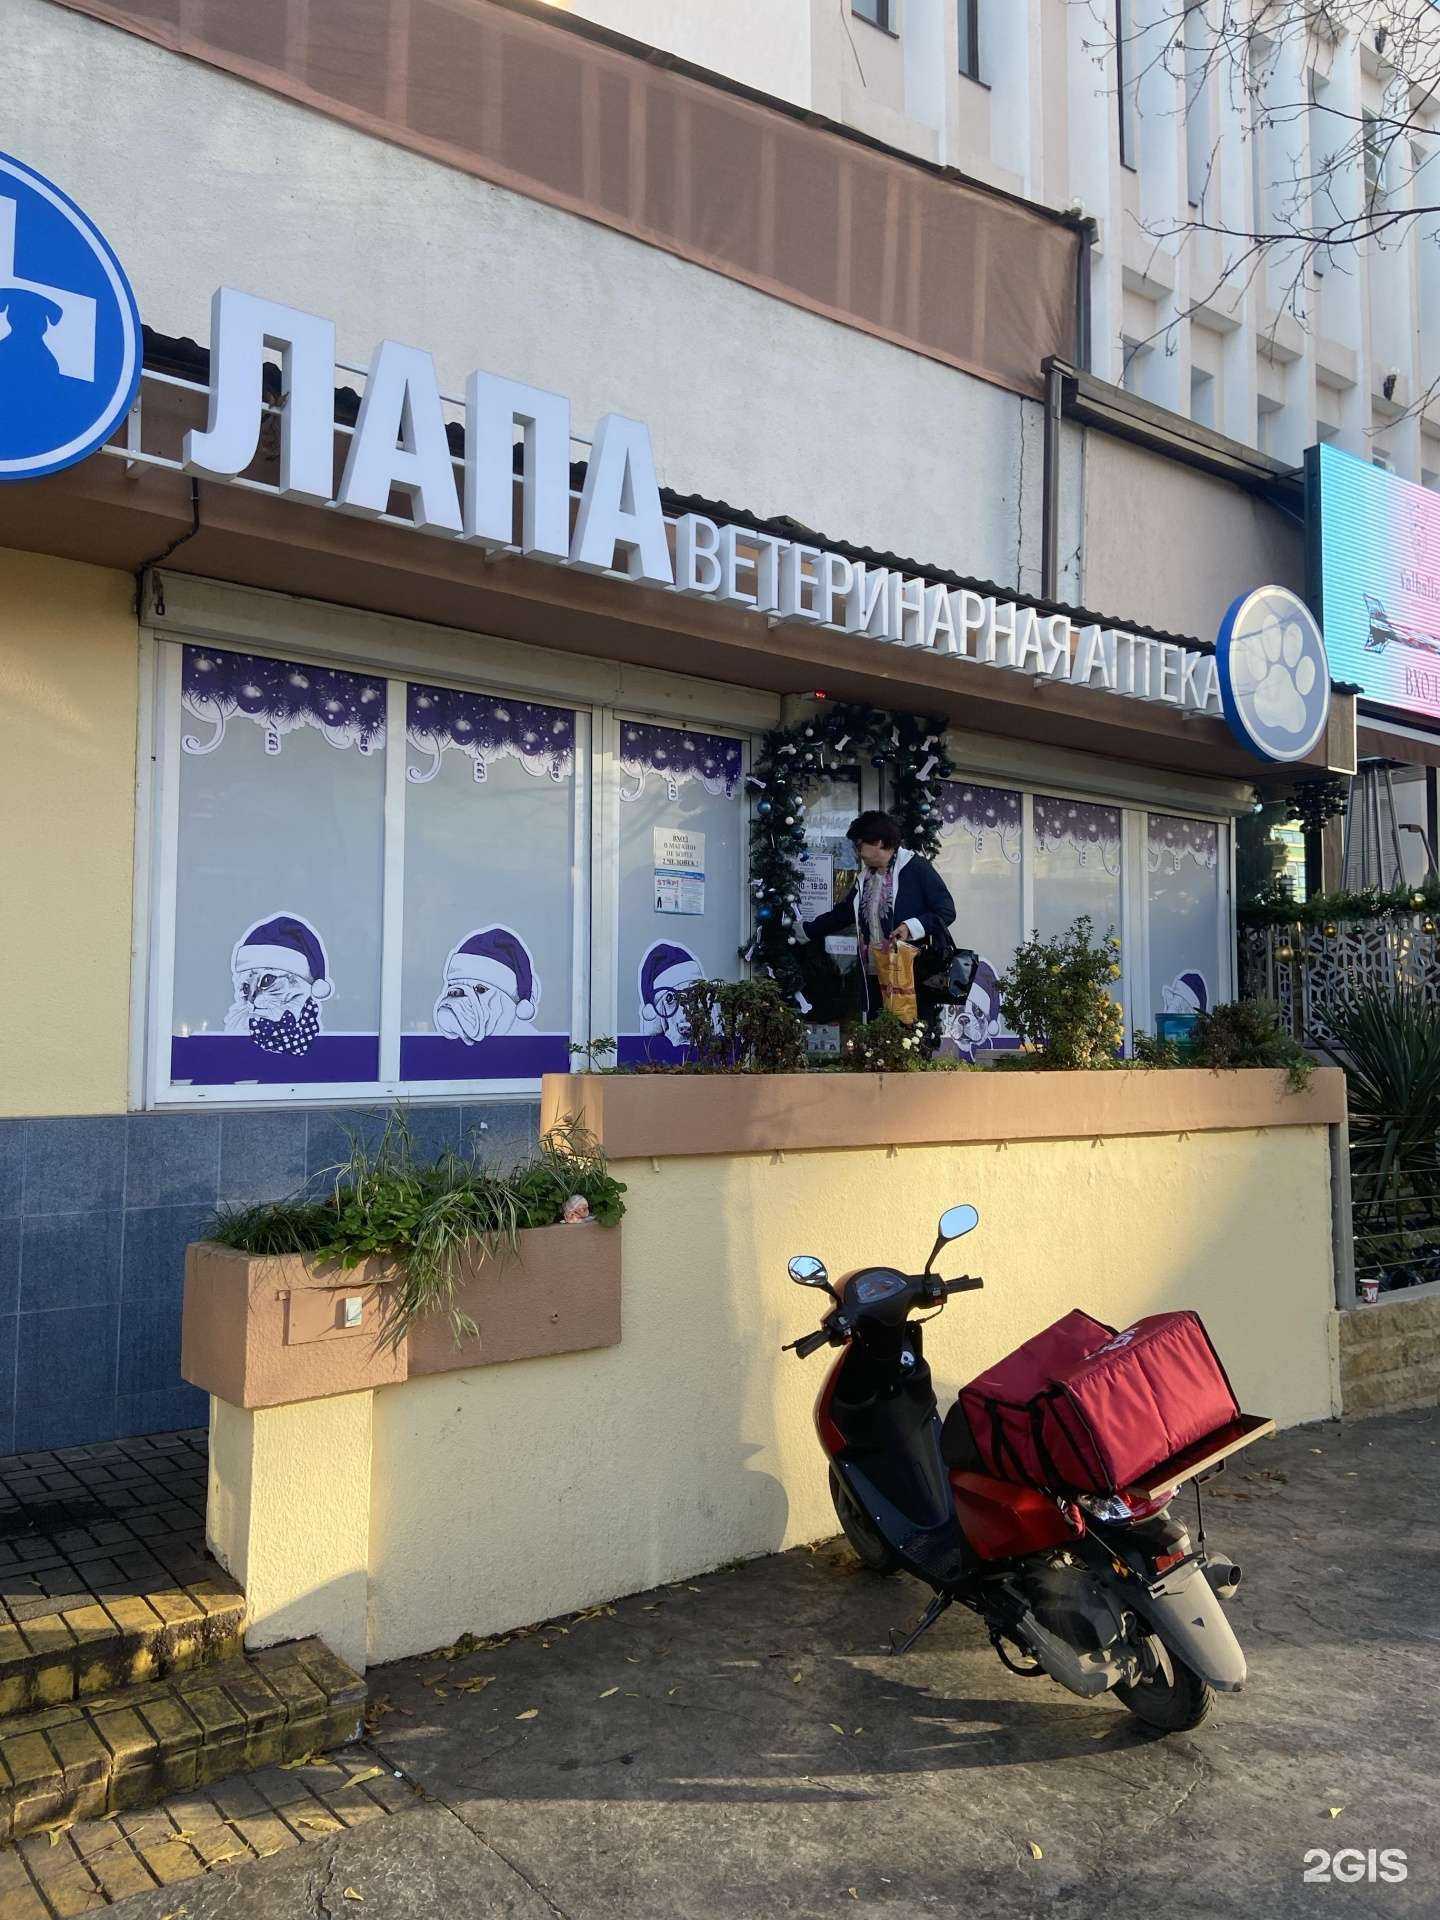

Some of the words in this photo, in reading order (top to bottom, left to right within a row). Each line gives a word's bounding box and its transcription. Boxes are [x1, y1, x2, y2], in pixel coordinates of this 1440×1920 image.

[183, 286, 675, 584] ЛАПА
[677, 512, 1072, 680] ВЕТЕРИНАРНАЯ
[1072, 624, 1225, 716] АПТЕКА
[811, 882, 828, 890] 19:00
